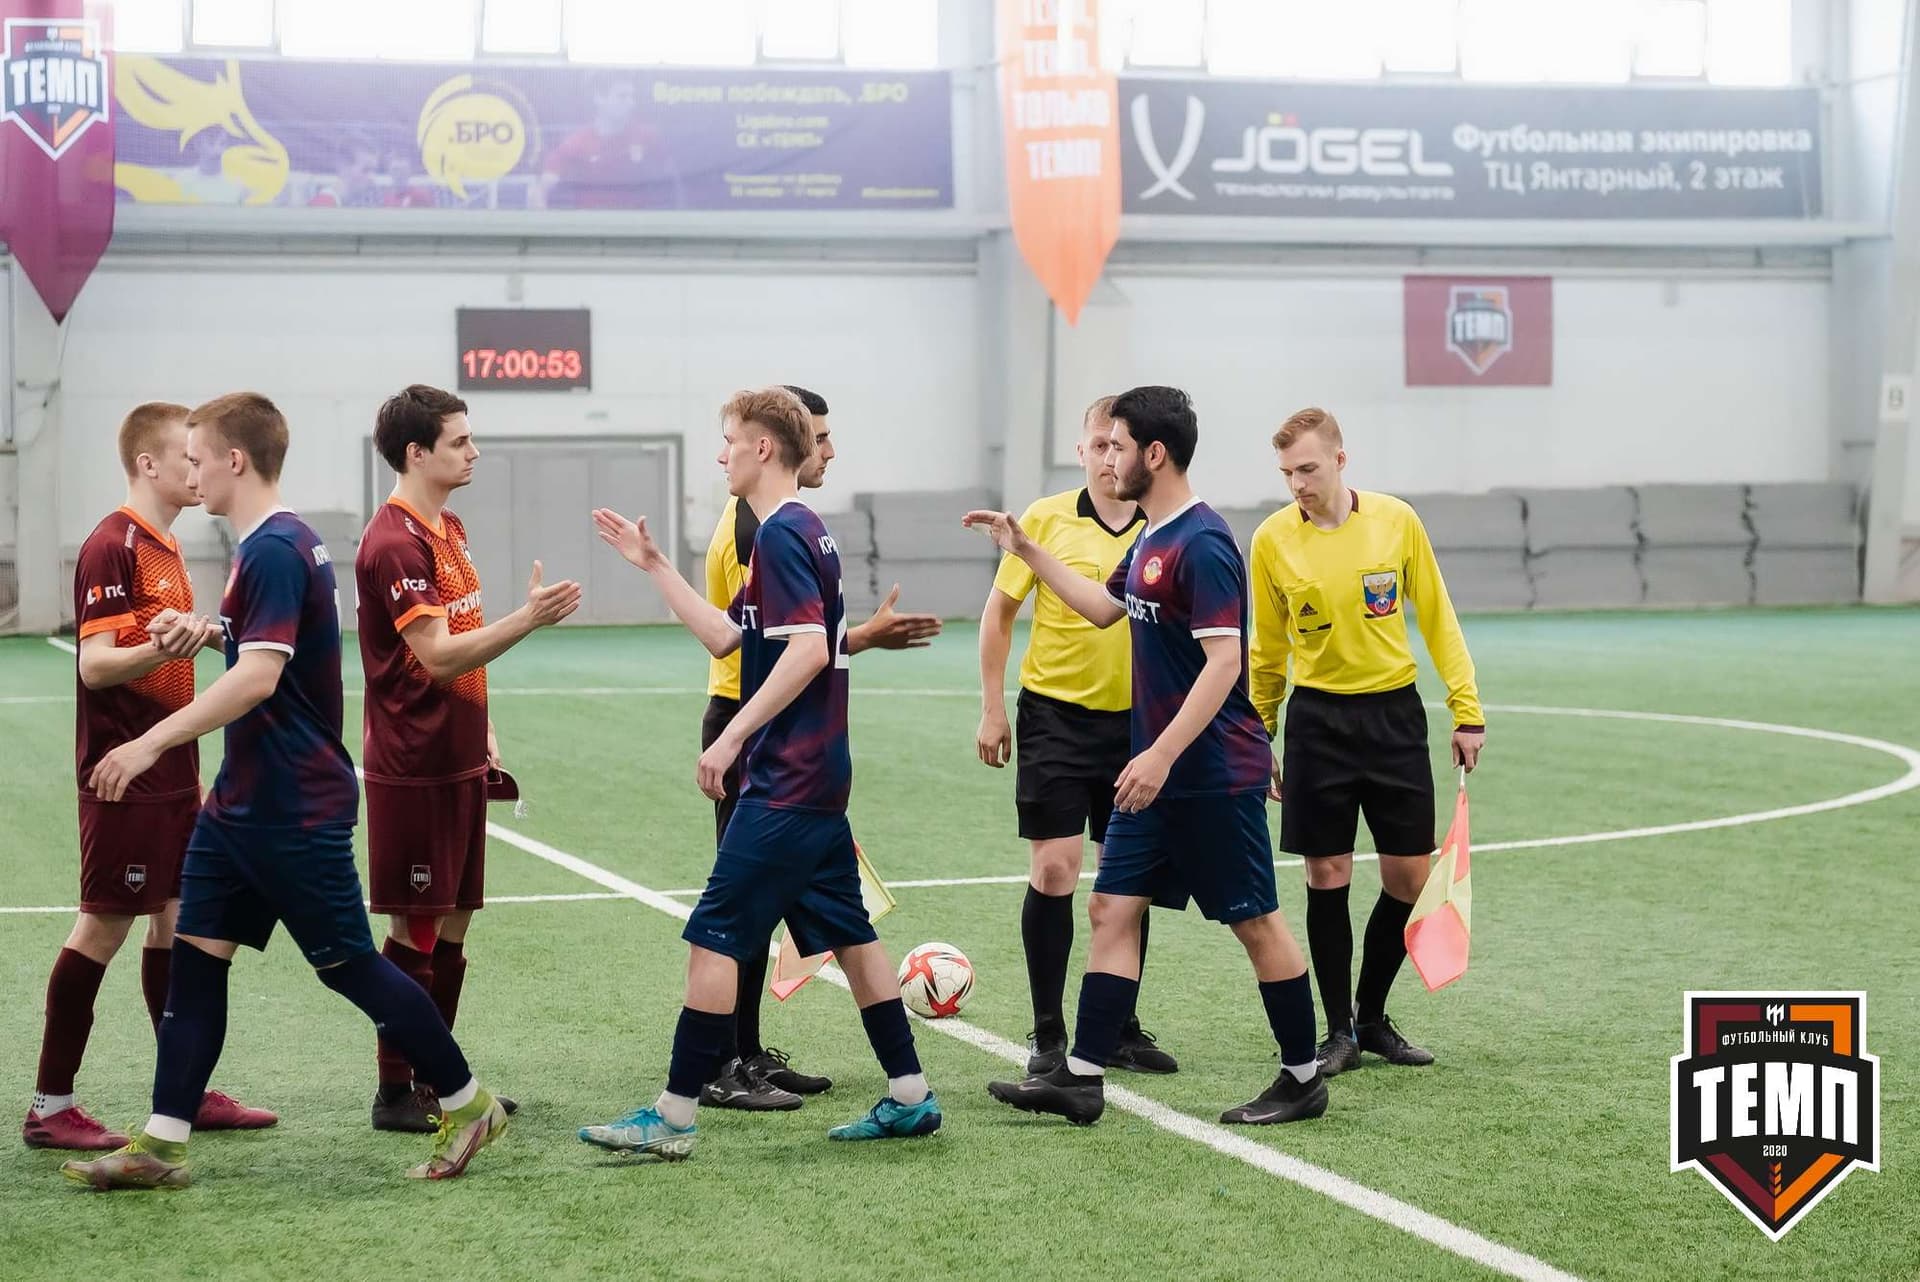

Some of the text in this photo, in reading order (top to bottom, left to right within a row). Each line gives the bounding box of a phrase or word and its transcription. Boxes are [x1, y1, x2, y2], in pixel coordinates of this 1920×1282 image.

[10, 57, 97, 106] ТЕМП
[1452, 123, 1813, 157] Футбольная экипировка
[1484, 159, 1784, 195] ТЦ Янтарный, 2 этаж
[463, 349, 582, 378] 17:00:53
